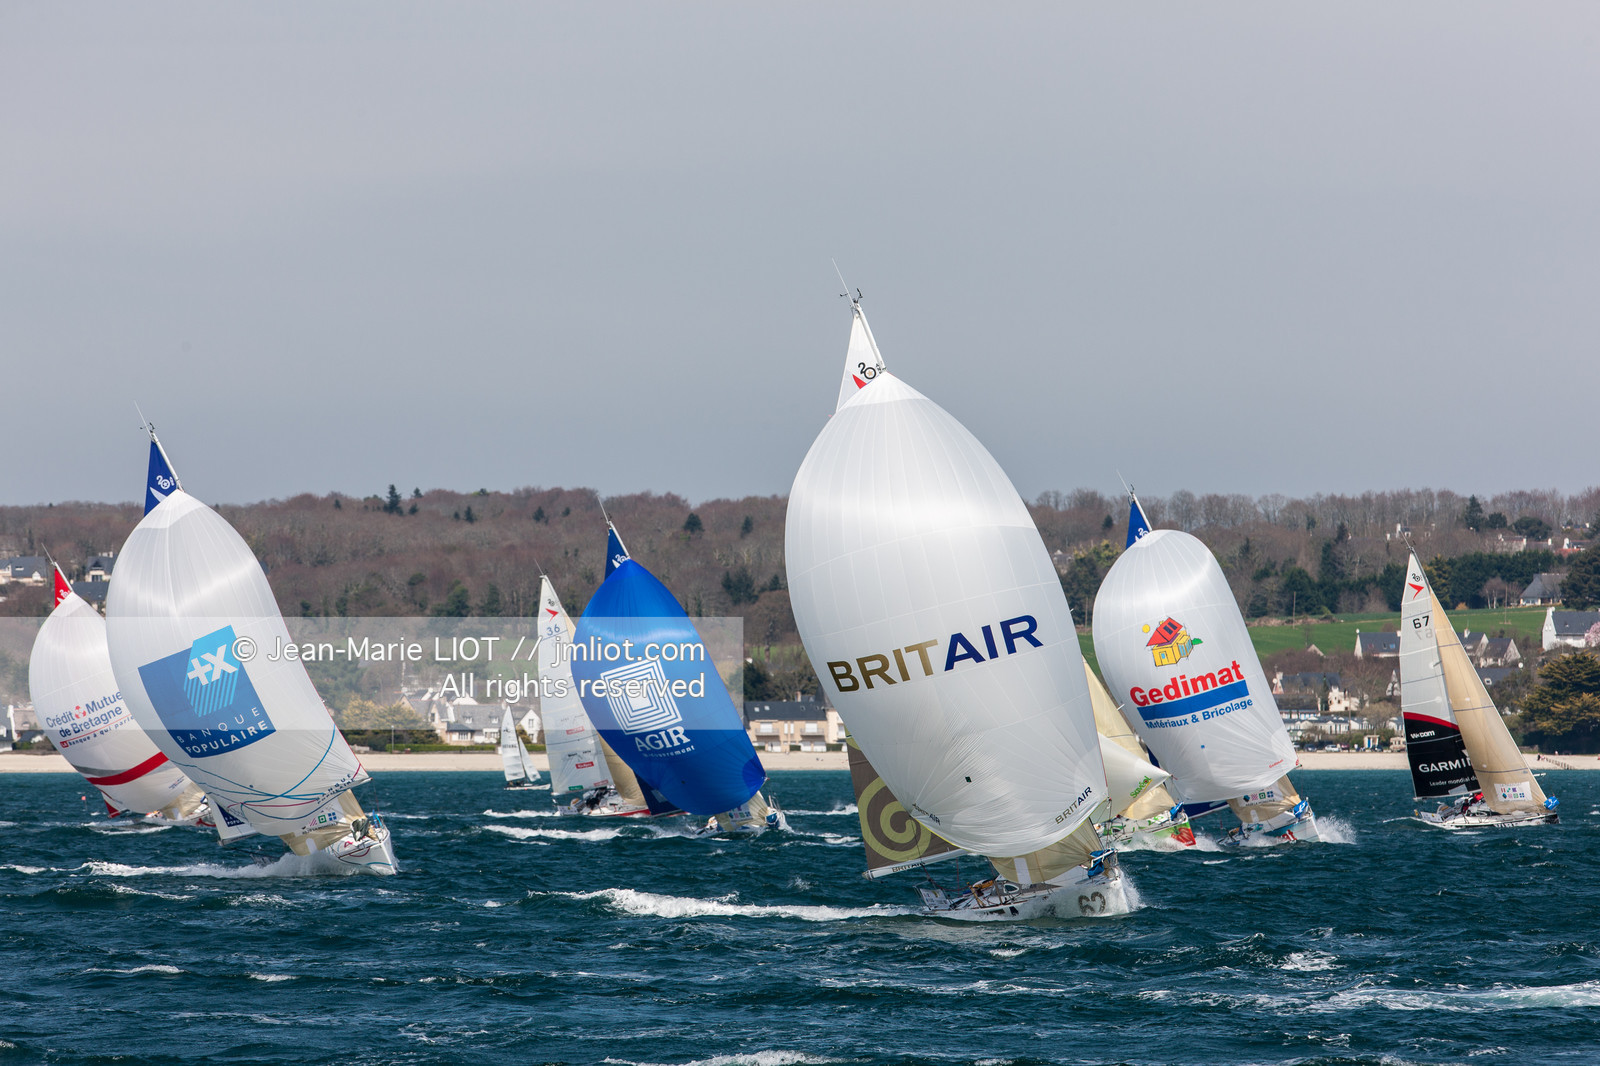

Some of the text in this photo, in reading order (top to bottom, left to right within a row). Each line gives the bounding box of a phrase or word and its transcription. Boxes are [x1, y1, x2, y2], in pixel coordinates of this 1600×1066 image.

[546, 624, 561, 635] 36
[1412, 615, 1429, 629] 67
[827, 615, 1043, 692] BRITAIR
[1130, 660, 1244, 707] Gedimat
[46, 691, 123, 728] Crédit Mutue
[60, 706, 122, 738] de Bretagne
[177, 707, 260, 743] BANQUE
[1191, 714, 1200, 723] &
[1202, 699, 1253, 720] Bricolage
[186, 720, 268, 753] POPULAIRE
[635, 726, 690, 751] AGIR
[1055, 786, 1092, 824] BRITAIR
